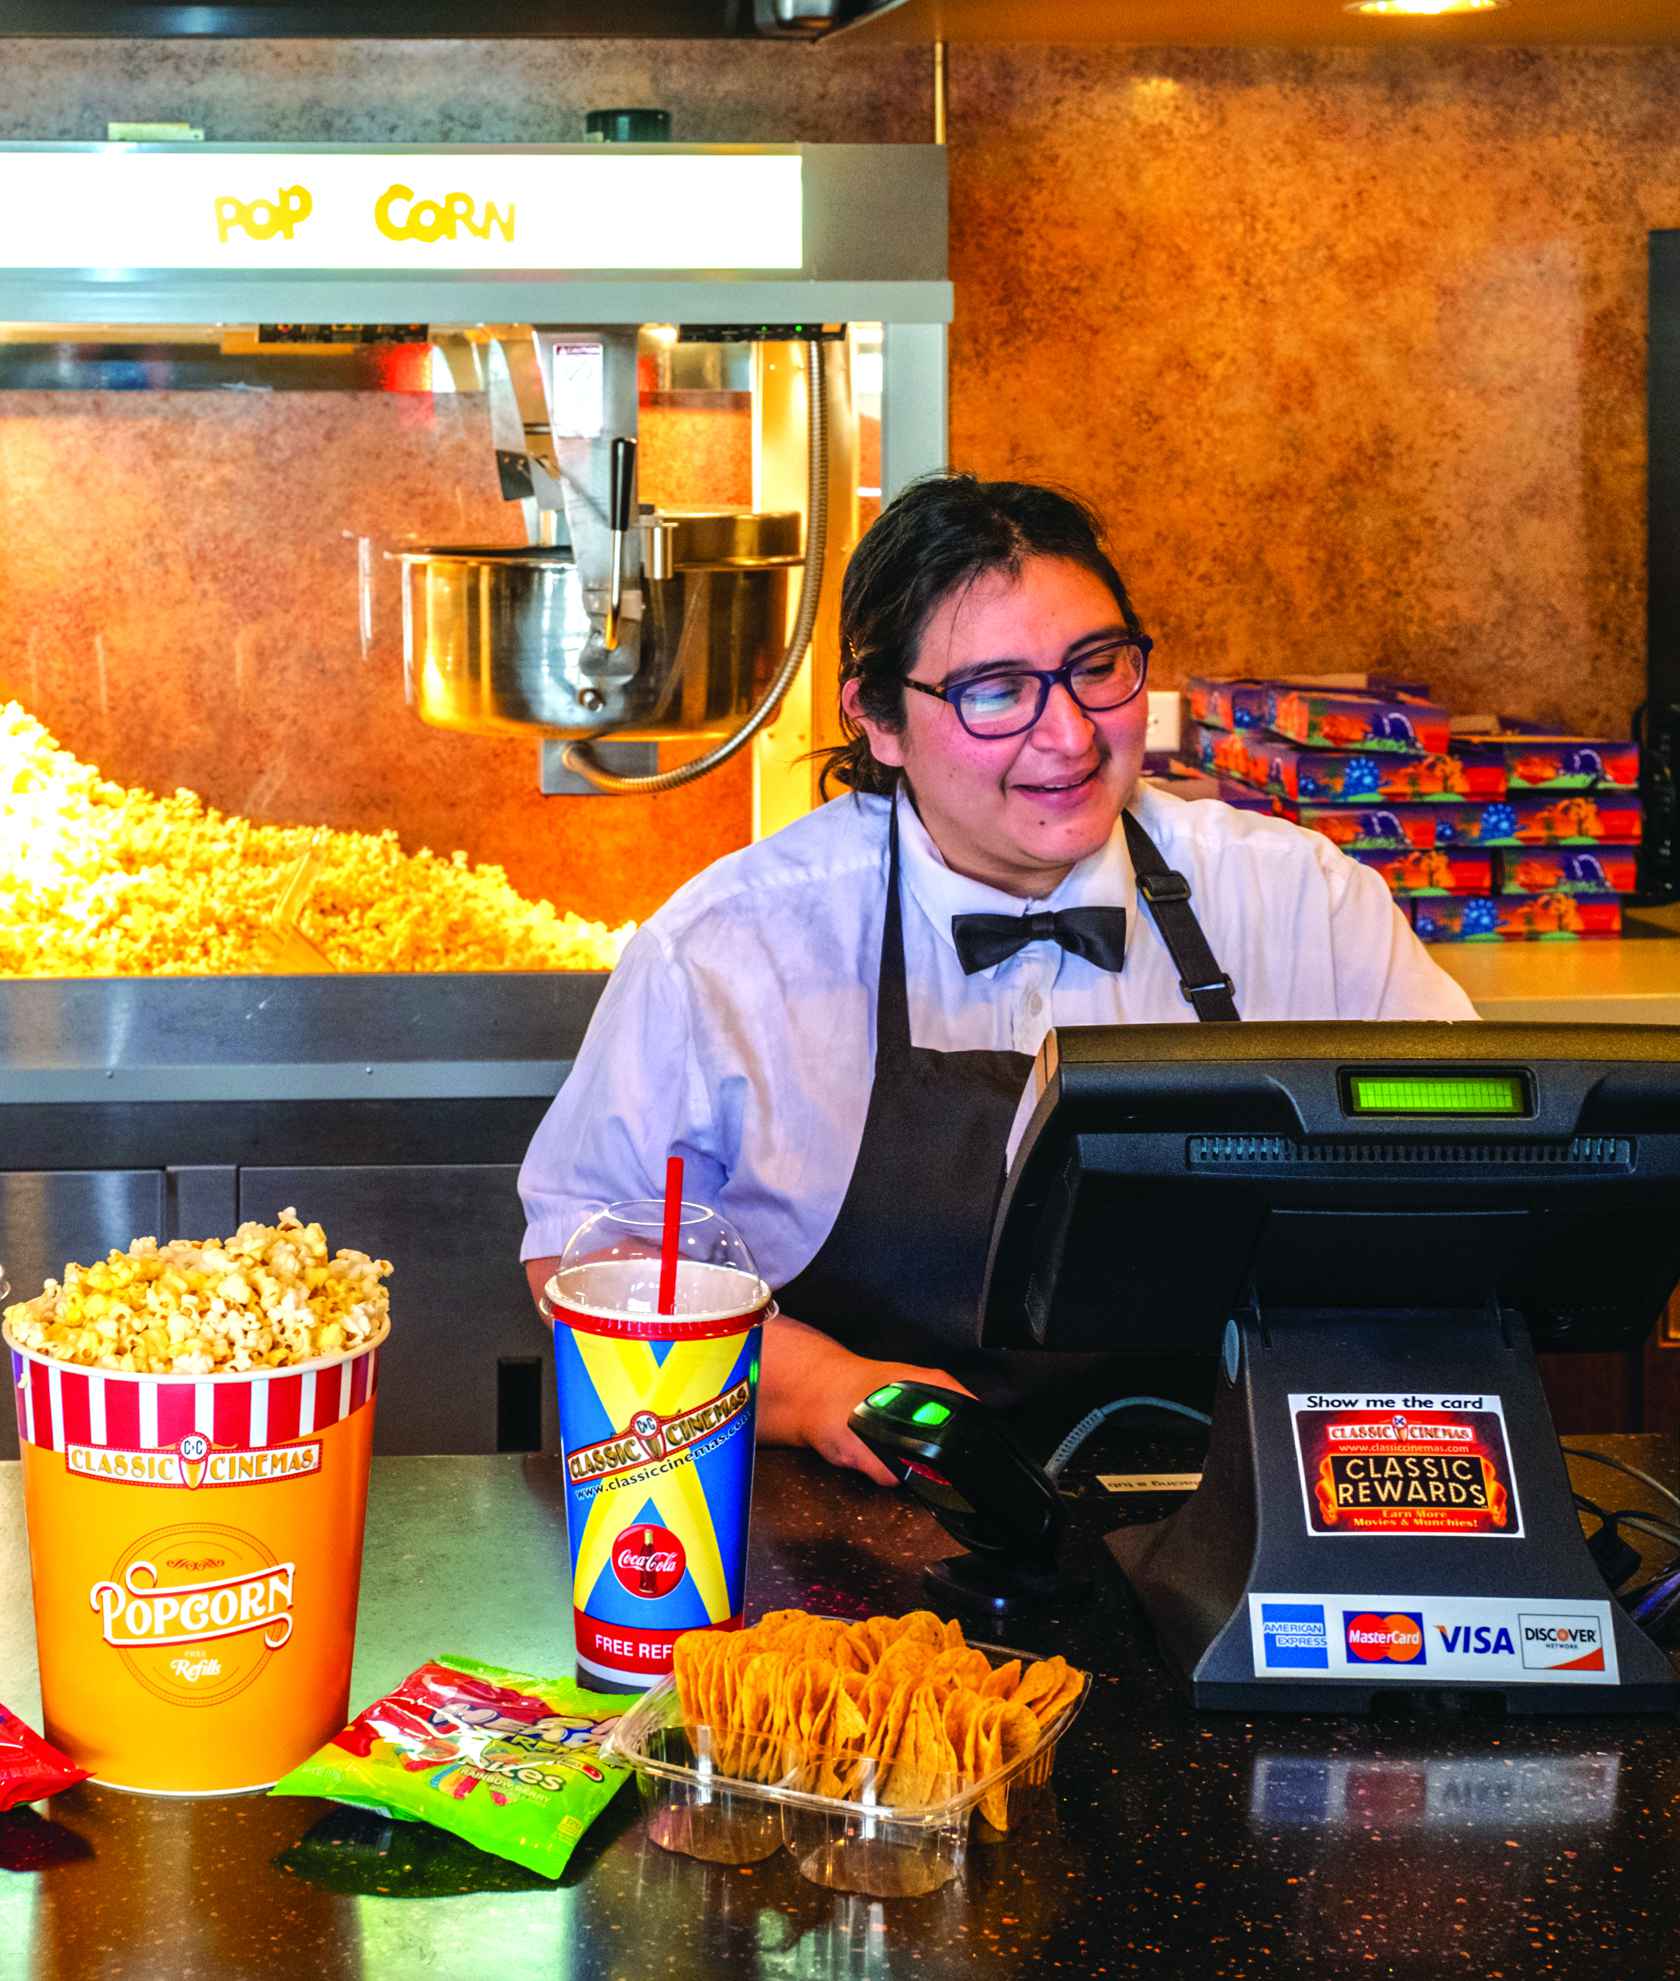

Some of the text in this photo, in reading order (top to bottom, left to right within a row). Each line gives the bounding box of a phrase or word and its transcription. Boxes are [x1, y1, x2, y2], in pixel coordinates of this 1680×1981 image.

[214, 184, 516, 243] POP CORN
[1307, 1395, 1483, 1409] Show me the card
[570, 1386, 748, 1479] CLASSIC CINEMAS
[1331, 1426, 1470, 1440] CLASSIC CINEMAS
[1338, 1442, 1469, 1453] www.classiccinemas.com
[71, 1447, 314, 1481] CLASSIC CINEMAS
[1345, 1457, 1473, 1480] CLASSIC
[1338, 1480, 1486, 1506] REWARDS
[1354, 1518, 1478, 1528] Movies & Munchies!
[1381, 1510, 1447, 1519] Earn More
[90, 1562, 295, 1647] POPCORN
[1264, 1623, 1322, 1633] AMERICAN
[1349, 1629, 1420, 1645] MasterCard
[1524, 1627, 1596, 1643] DISCOVER
[595, 1634, 673, 1660] FREE REF
[1277, 1636, 1327, 1647] EXPRESS
[1434, 1625, 1516, 1655] VISA
[170, 1659, 222, 1682] Refills
